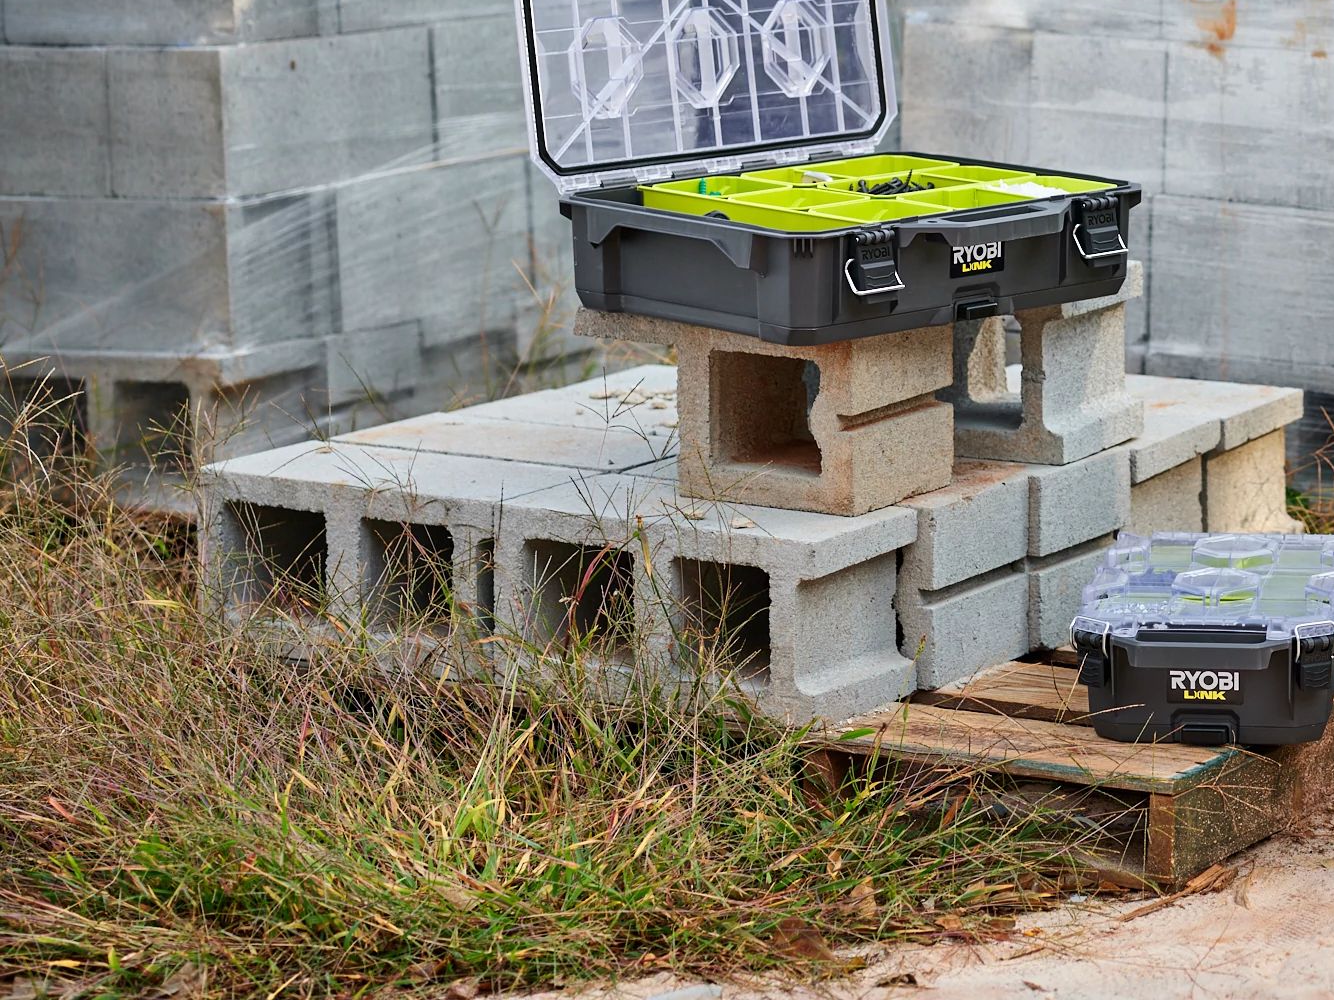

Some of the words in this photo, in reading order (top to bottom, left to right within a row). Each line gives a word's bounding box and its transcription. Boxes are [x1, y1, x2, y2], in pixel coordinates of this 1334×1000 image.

[860, 245, 890, 261] RYOBI
[952, 241, 1002, 264] RYOBI
[1169, 670, 1240, 691] RYOBI
